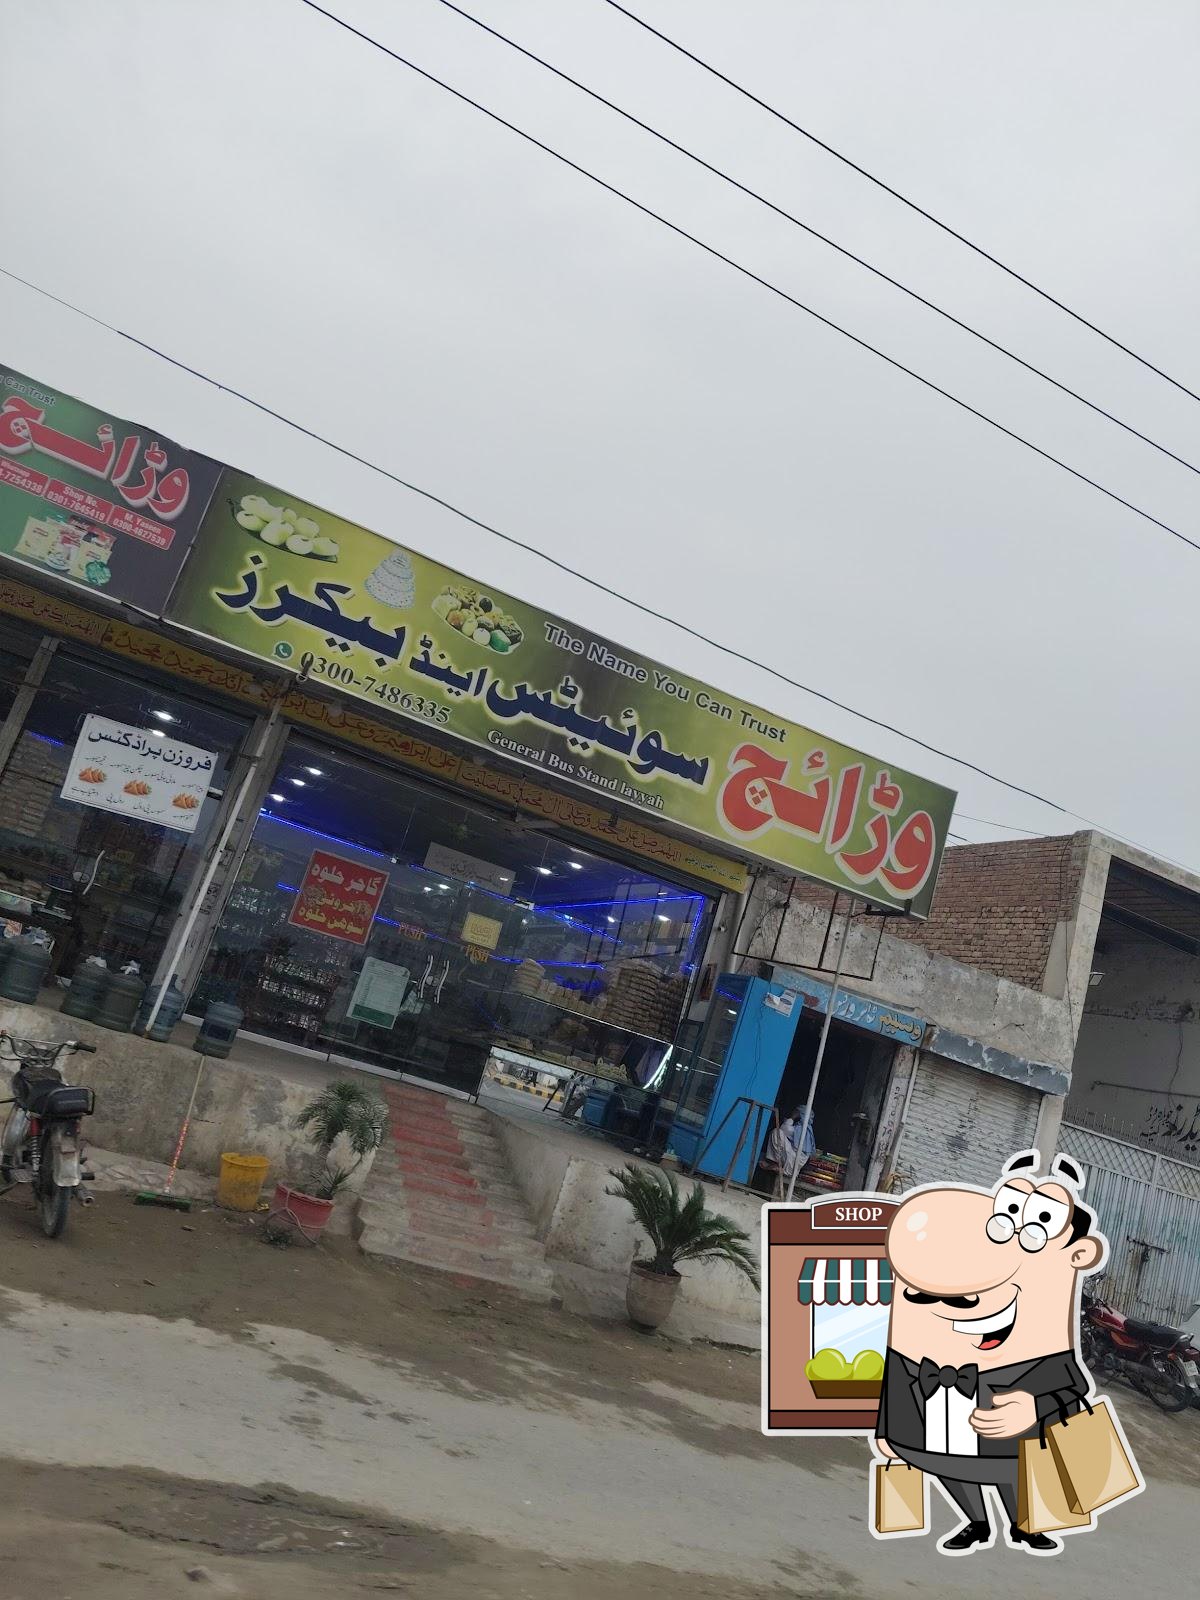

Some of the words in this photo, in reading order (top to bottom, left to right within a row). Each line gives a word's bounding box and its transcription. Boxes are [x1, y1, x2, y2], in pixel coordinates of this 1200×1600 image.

[5, 377, 26, 393] Can
[28, 386, 55, 406] Trust
[63, 486, 84, 501] Shop
[213, 553, 408, 669] بیکرز
[299, 650, 451, 724] 0300-7486335
[543, 622, 584, 655] The
[588, 639, 647, 684] Name
[653, 669, 690, 702] You
[696, 692, 733, 721] Can
[739, 709, 787, 744] Trust
[162, 749, 212, 771] فروزن
[487, 730, 546, 763] General
[548, 752, 575, 774] Bus
[577, 763, 620, 792] Stand
[719, 742, 937, 896] وڑائچ
